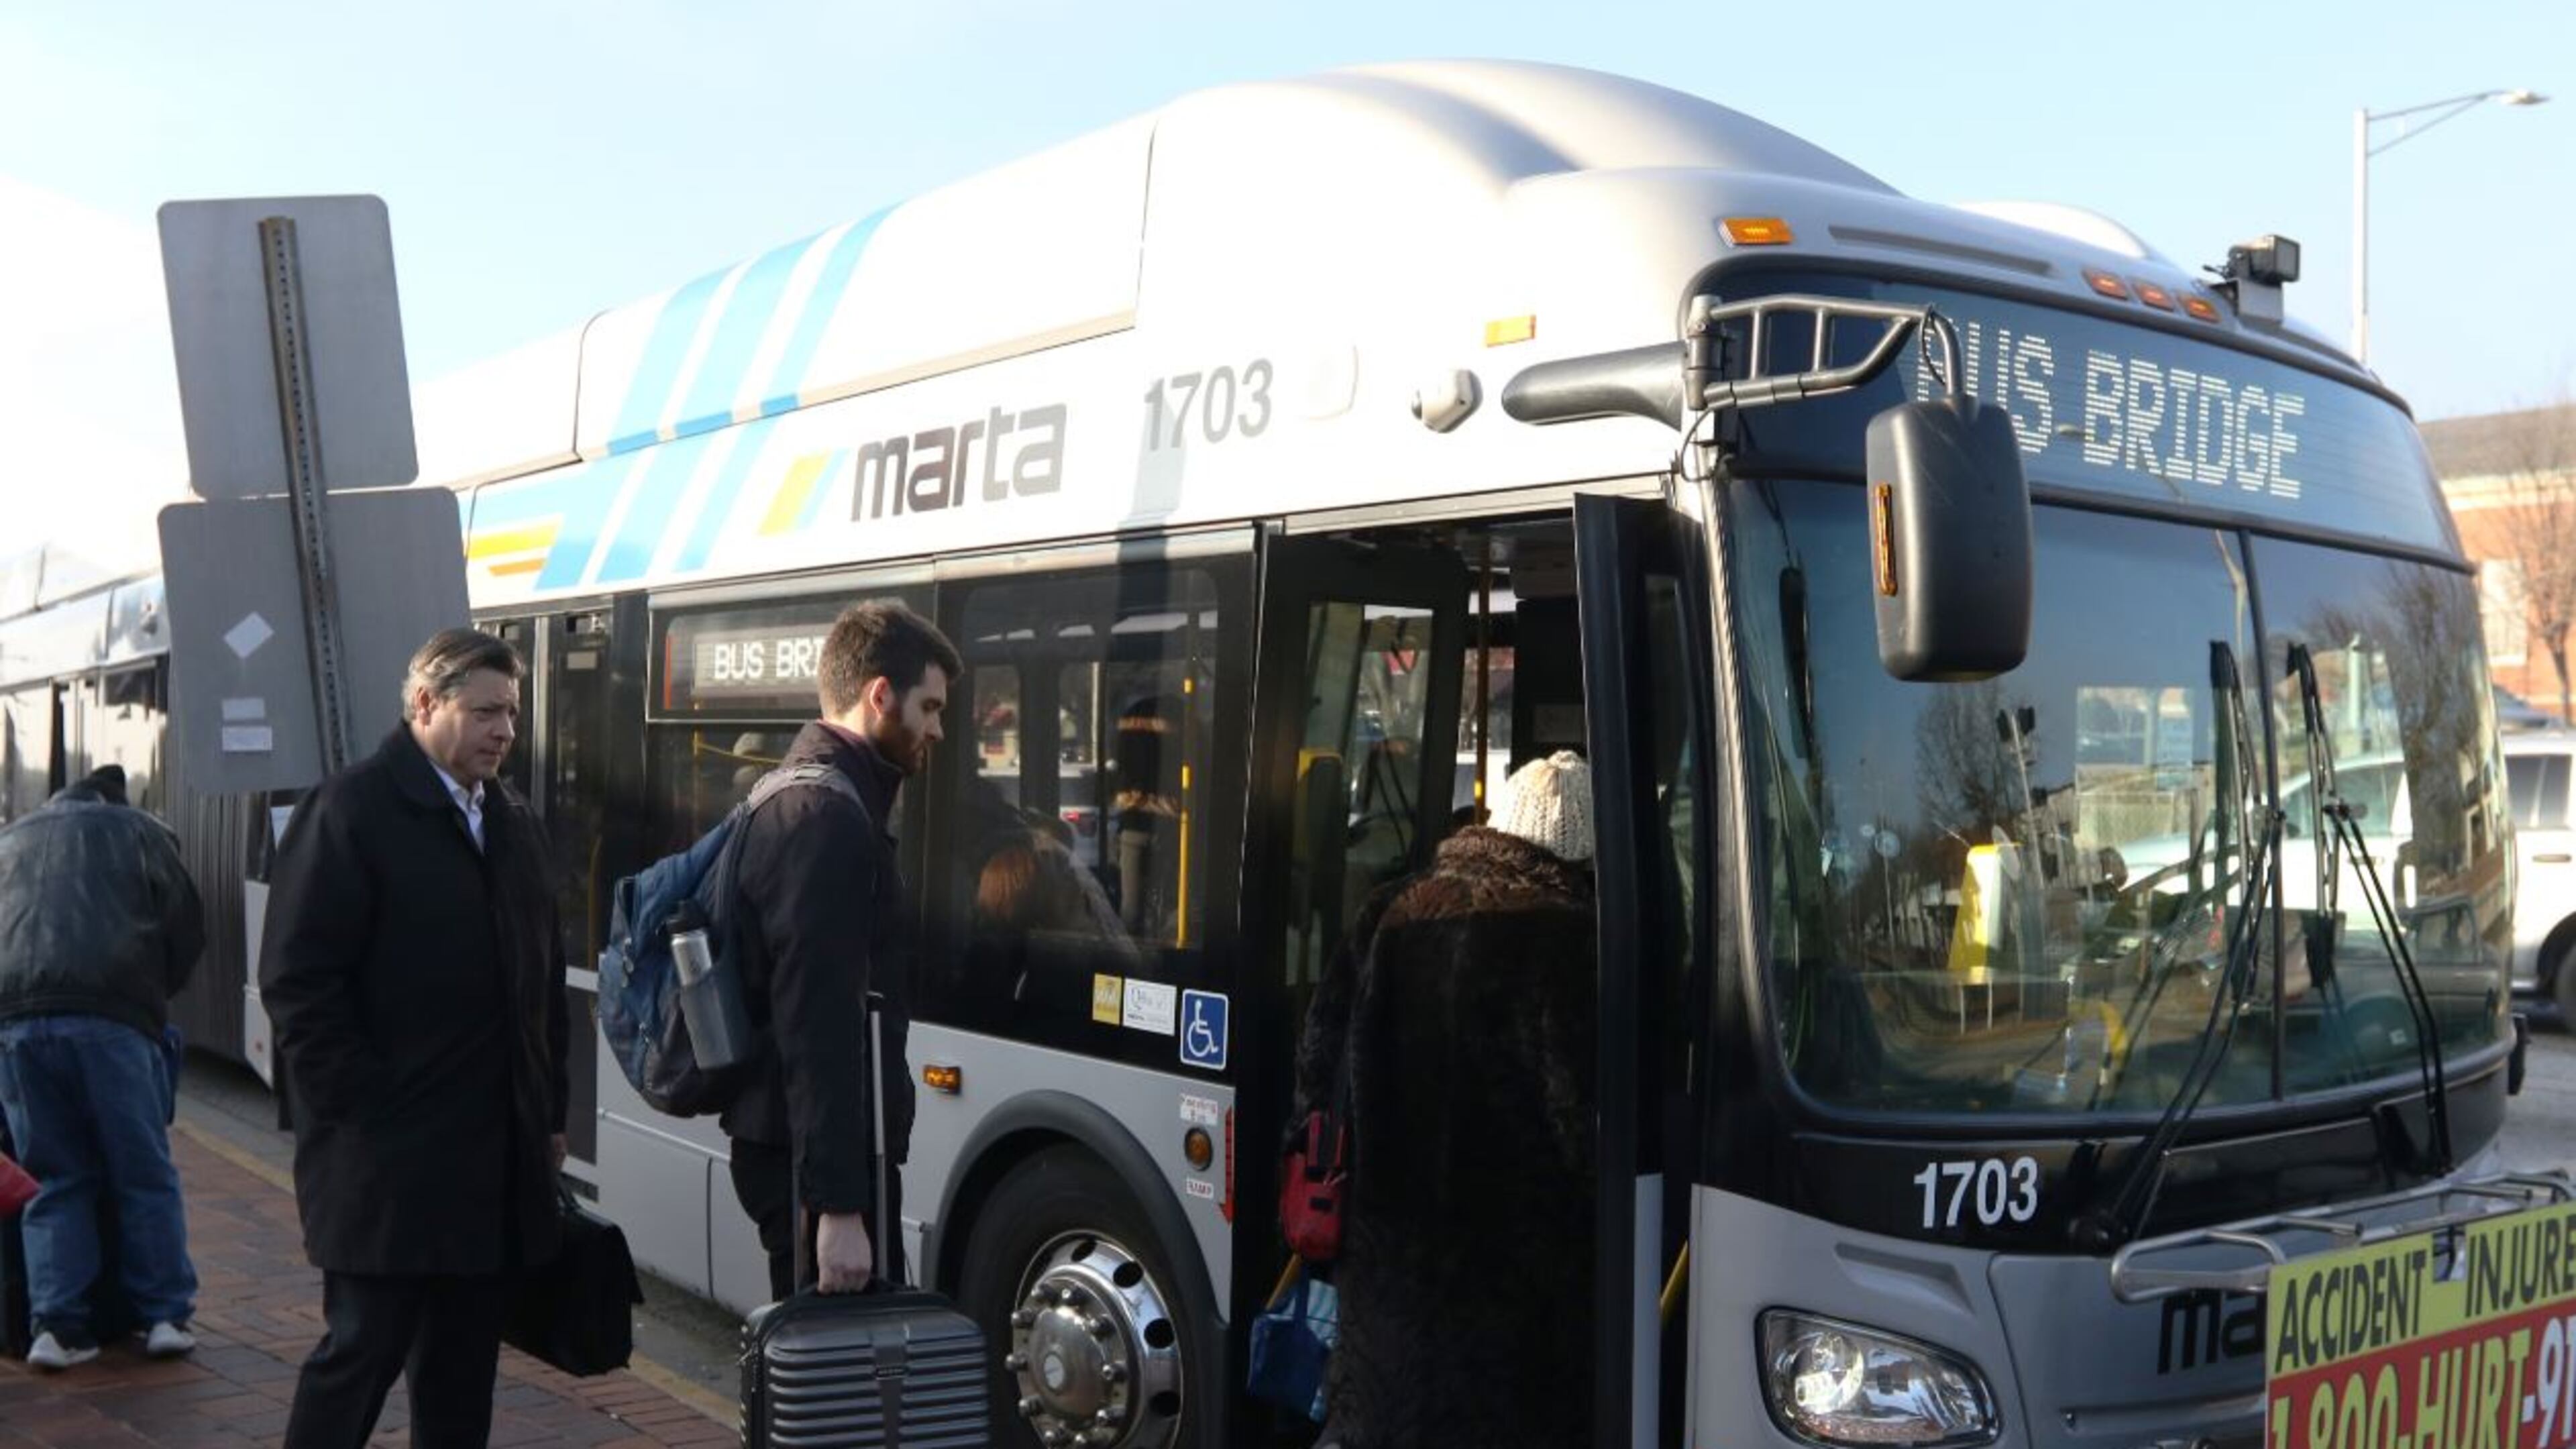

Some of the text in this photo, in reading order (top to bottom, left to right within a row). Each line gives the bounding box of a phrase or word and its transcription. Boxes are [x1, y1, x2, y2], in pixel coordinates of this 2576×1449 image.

[1144, 358, 1274, 451] 1703
[2084, 349, 2305, 499] BRIDGE
[851, 403, 1067, 522] marta
[714, 642, 765, 679] BUS
[1913, 1156, 2037, 1228] 1703
[2275, 1249, 2426, 1374] ACCIDENT
